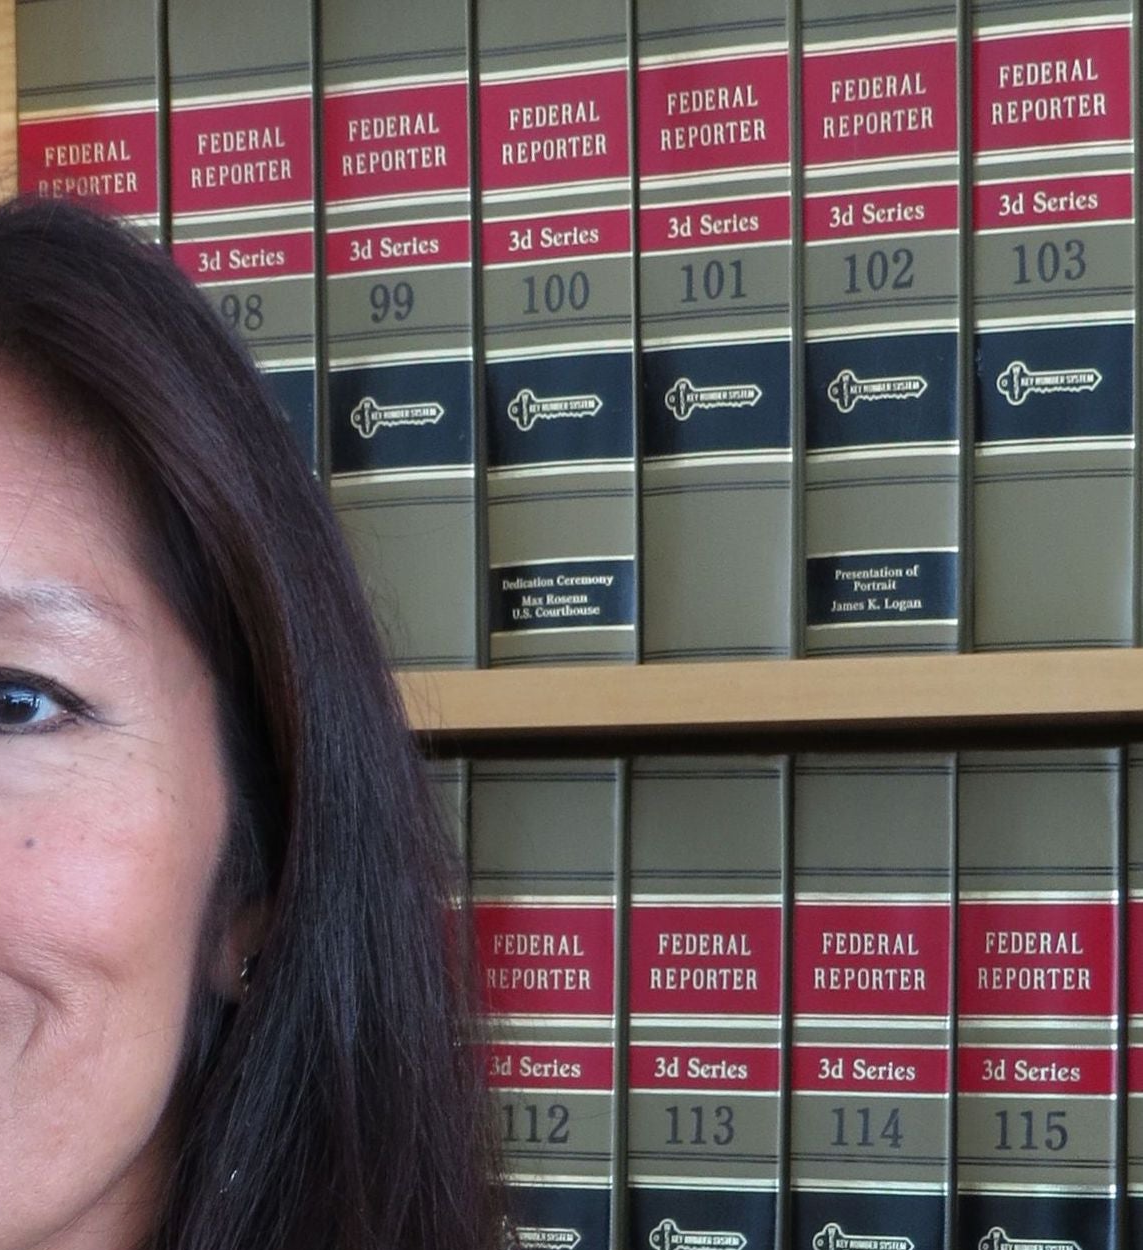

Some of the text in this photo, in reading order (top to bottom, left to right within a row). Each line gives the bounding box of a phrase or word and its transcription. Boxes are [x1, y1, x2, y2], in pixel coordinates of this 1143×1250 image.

[999, 58, 1098, 89] FEDERAL
[667, 85, 758, 115] FEDERAL
[831, 73, 926, 103] FEDERAL
[509, 100, 600, 130] FEDERAL
[991, 93, 1107, 126] REPORTER
[348, 112, 439, 142] FEDERAL
[660, 119, 766, 151] REPORTER
[823, 107, 933, 139] REPORTER
[44, 140, 131, 167] FEDERAL
[198, 127, 286, 155] FEDERAL
[502, 134, 607, 165] REPORTER
[191, 159, 292, 189] REPORTER
[342, 145, 447, 177] REPORTER
[829, 202, 925, 228] 3d Series
[999, 191, 1098, 217] 3d Series
[508, 226, 599, 251] 3d Series
[667, 214, 759, 239] 3d Series
[198, 248, 285, 273] 3d Series
[350, 237, 439, 261] 3d Series
[1012, 239, 1087, 285] 103
[680, 259, 747, 303] 101
[844, 248, 915, 294] 102
[369, 281, 414, 323] 99
[522, 271, 590, 315] 100
[220, 293, 264, 332] 98
[502, 574, 614, 590] Dedication Ceremony
[834, 565, 919, 581] Presentation of
[853, 579, 897, 592] Portrait
[512, 605, 600, 619] U.S. Courthouse
[521, 595, 543, 607] Max
[831, 597, 922, 613] James K. Logan
[493, 934, 584, 956] FEDERAL
[658, 933, 752, 956] FEDERAL
[823, 933, 919, 956] FEDERAL
[985, 932, 1084, 955] FEDERAL
[487, 968, 591, 990] REPORTER
[650, 968, 758, 991] REPORTER
[814, 967, 926, 991] REPORTER
[978, 967, 1091, 991] REPORTER
[490, 1055, 581, 1078] 3d Series
[654, 1057, 748, 1080] 3d Series
[818, 1057, 916, 1081] 3d Series
[983, 1059, 1081, 1082] 3d Series
[502, 1103, 569, 1144] 112
[666, 1105, 734, 1146] 113
[831, 1106, 903, 1149] 114
[995, 1109, 1068, 1151] 115
